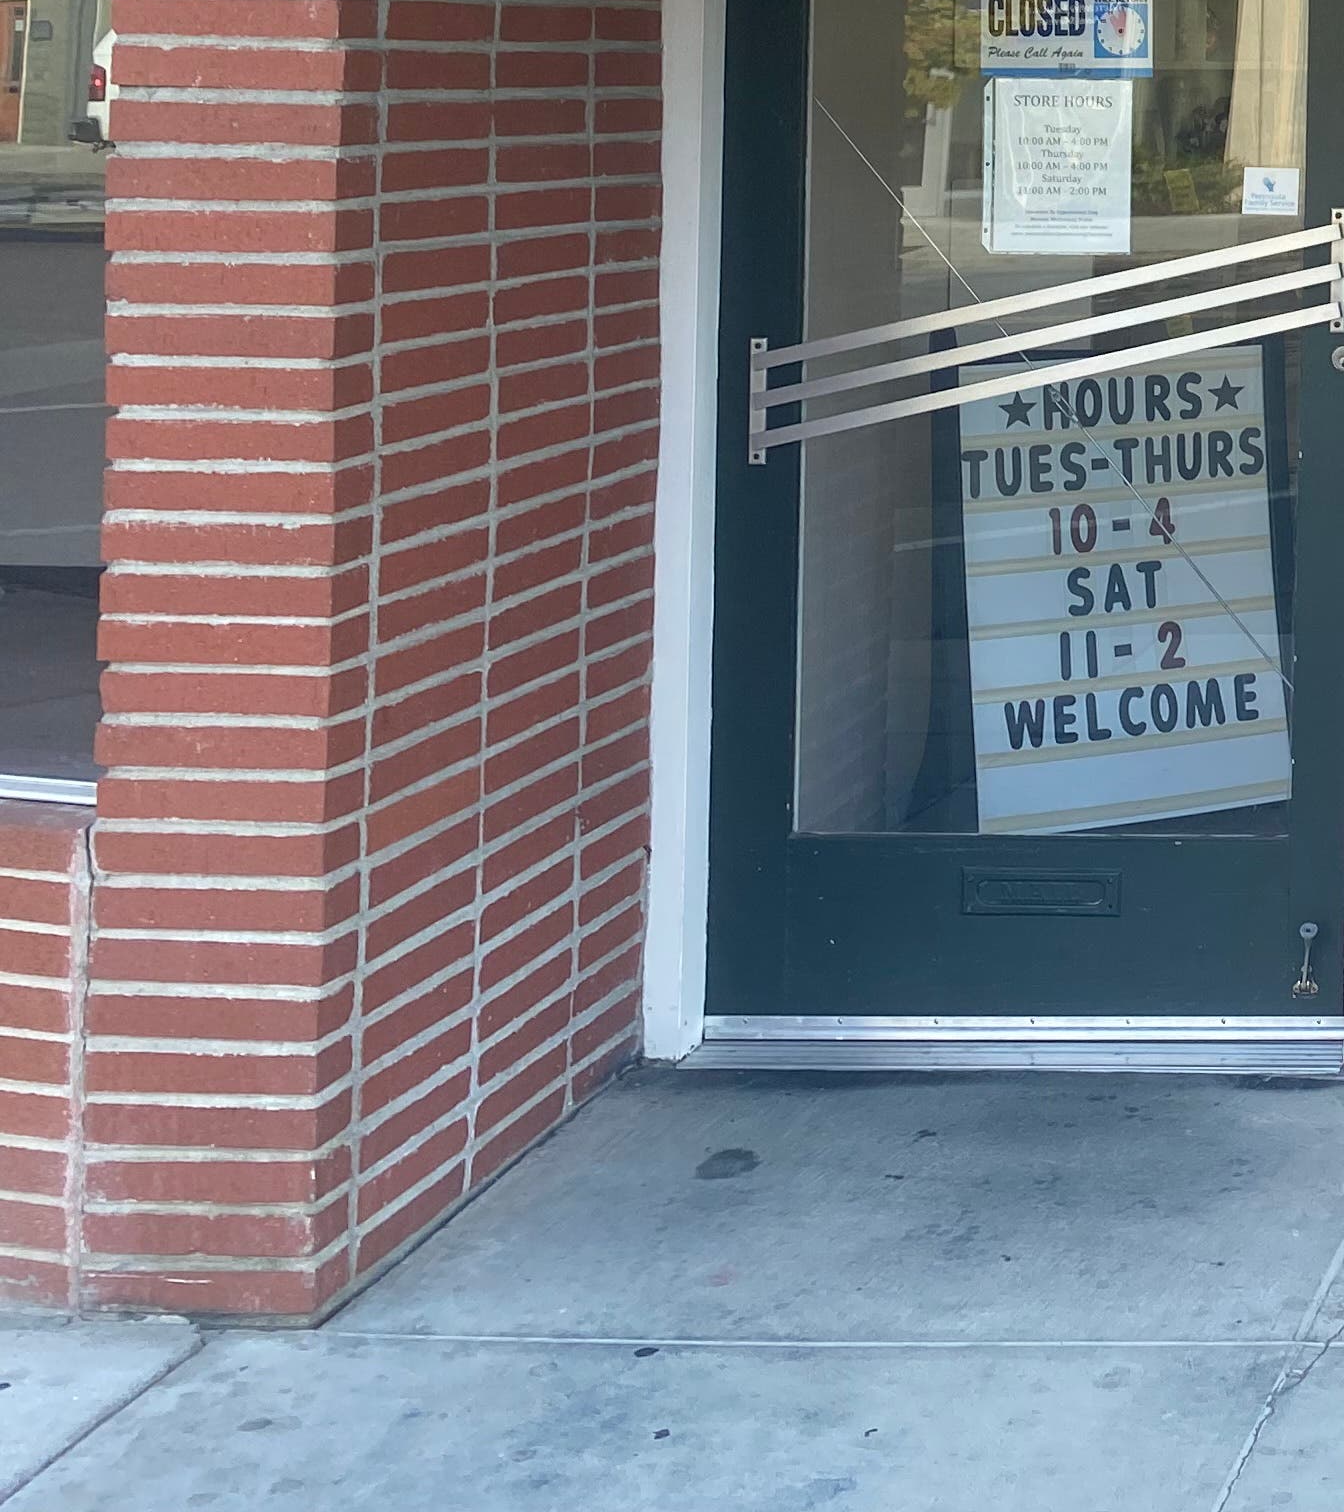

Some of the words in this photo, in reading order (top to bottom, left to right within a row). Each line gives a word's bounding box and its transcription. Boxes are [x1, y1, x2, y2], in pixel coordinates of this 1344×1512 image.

[988, 46, 1020, 58] Please
[1024, 46, 1048, 58] Call
[1050, 46, 1083, 62] Again
[1013, 94, 1059, 107] STORE
[1064, 95, 1113, 108] HOURS
[1043, 124, 1081, 134] Tuesday
[1018, 137, 1043, 145] 10:00
[1045, 137, 1060, 145] AM
[1071, 137, 1091, 145] 4:00
[1094, 137, 1108, 146] PM
[1041, 149, 1083, 160] Thursday
[1017, 161, 1043, 170] 10:00
[1045, 162, 1060, 170] AM
[1071, 162, 1091, 170] 4:00
[1093, 163, 1108, 171] PM
[1042, 173, 1082, 184] Saturday
[1045, 187, 1060, 195] AM
[1070, 187, 1090, 195] 2:00
[1092, 187, 1107, 196] PM
[1042, 371, 1203, 430] HOURS
[961, 427, 1266, 499] TUES-THURS
[1066, 559, 1163, 617] SAT
[1004, 673, 1260, 751] WELCOME
